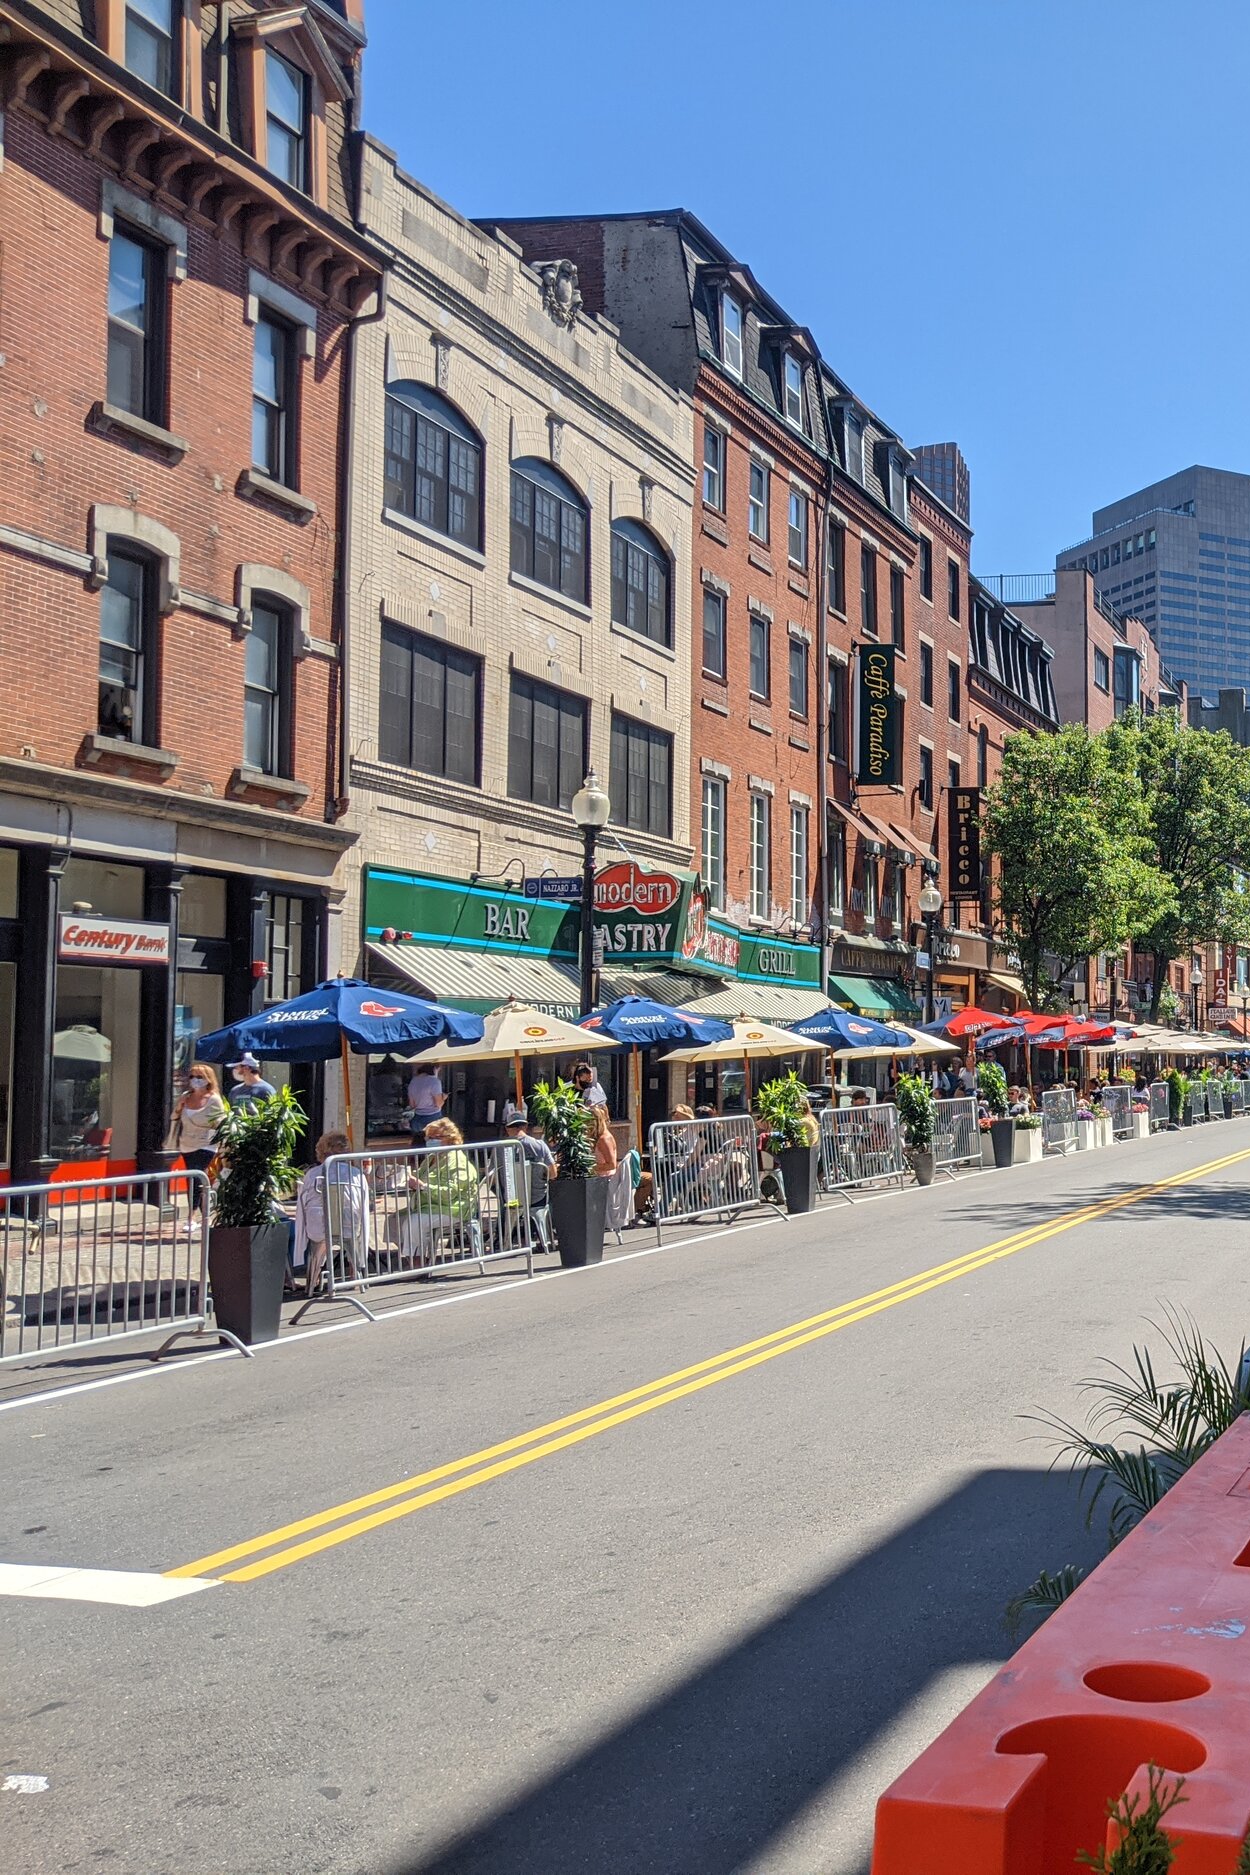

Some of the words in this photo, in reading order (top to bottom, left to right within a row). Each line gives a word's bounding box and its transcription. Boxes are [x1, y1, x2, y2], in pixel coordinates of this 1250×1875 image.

[865, 654, 889, 698] Caffè
[869, 704, 889, 775] Paradiso
[957, 795, 971, 885] Bricco
[543, 884, 569, 893] NAZZARO
[593, 864, 672, 904] modern
[484, 903, 531, 940] BAR
[596, 923, 672, 952] ASTRY
[63, 925, 137, 954] Century
[136, 934, 168, 953] Bank
[759, 949, 796, 975] GRILL
[529, 1002, 574, 1018] ODERN
